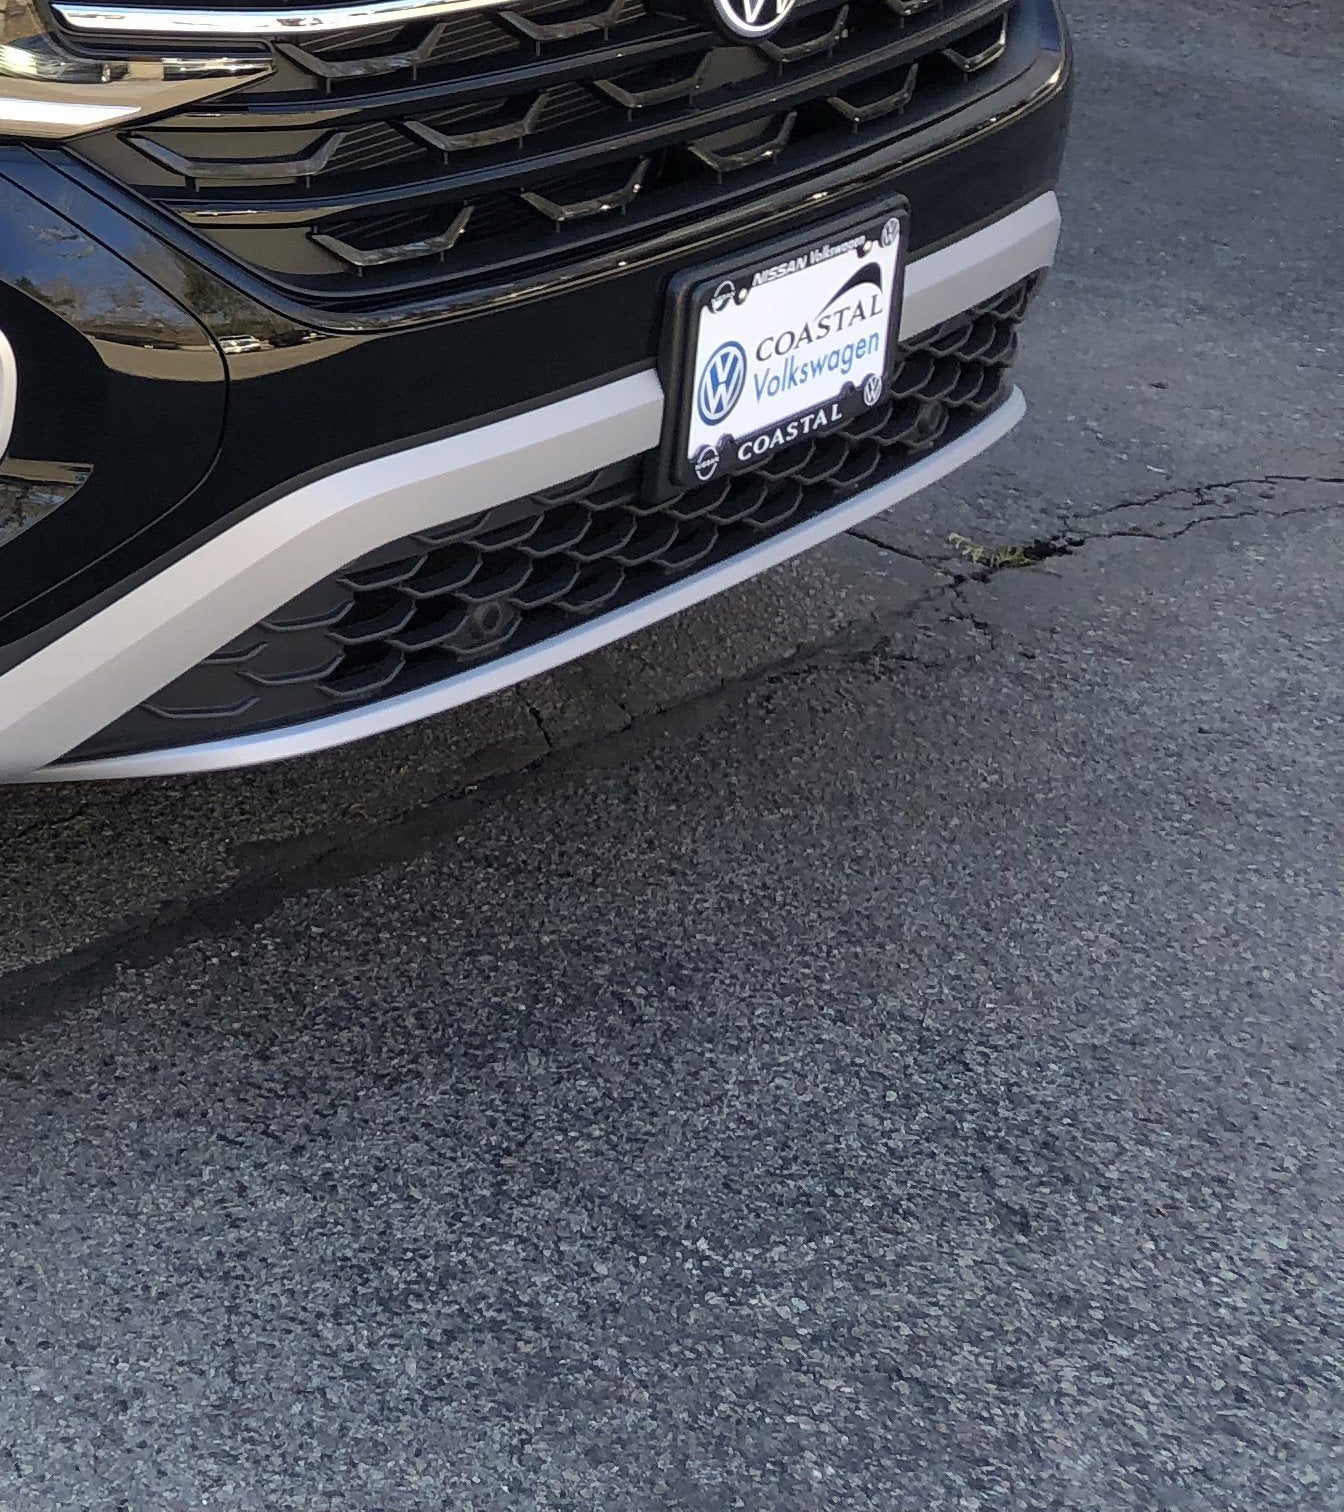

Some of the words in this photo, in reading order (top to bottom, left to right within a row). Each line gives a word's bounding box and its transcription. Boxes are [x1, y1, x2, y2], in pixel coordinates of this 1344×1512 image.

[751, 255, 808, 287] NISSAN
[755, 293, 884, 362] COASTAL
[753, 331, 880, 403] Volkswagen
[737, 403, 843, 461] COASTAL
